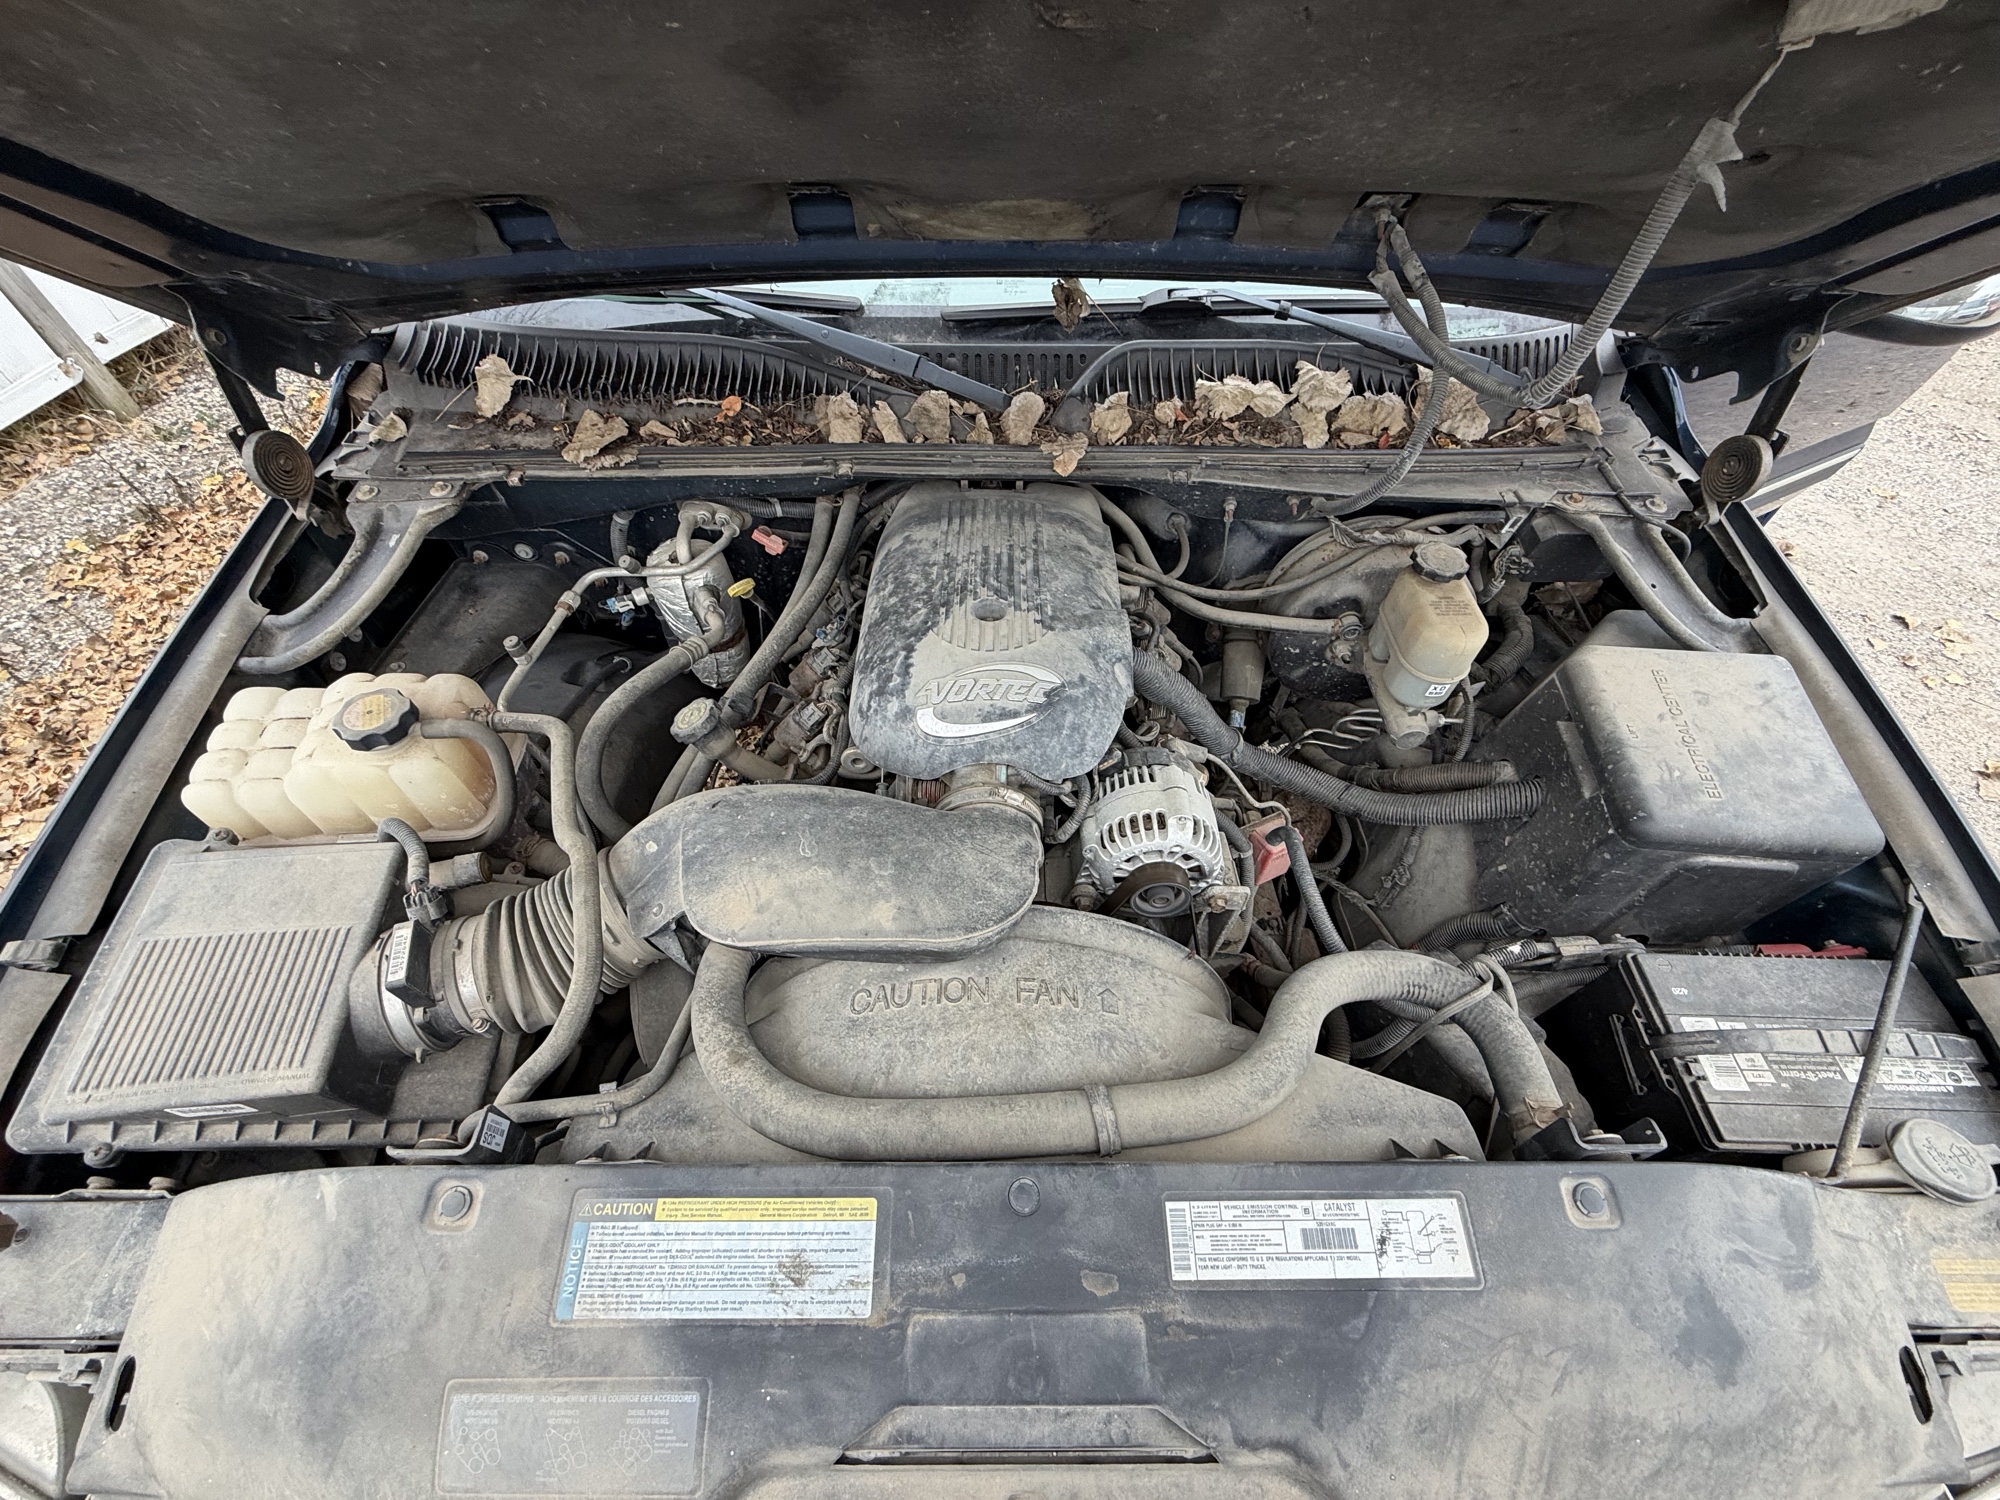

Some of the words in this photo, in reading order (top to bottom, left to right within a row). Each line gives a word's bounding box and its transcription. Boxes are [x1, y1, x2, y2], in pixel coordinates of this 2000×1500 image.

[923, 678, 1052, 704] VORTEC
[1650, 668, 1684, 718] CENTER
[1626, 724, 1640, 740] LIFT
[1674, 720, 1723, 800] ELECTRICAL
[849, 976, 990, 1016] CAUTION
[1016, 976, 1079, 1008] FAN
[1780, 1070, 1808, 1079] Farm
[1818, 1071, 1842, 1080] Fleet
[594, 1202, 654, 1216] CAUTION
[1324, 1203, 1355, 1212] CATALYST
[563, 1238, 584, 1298] NOTICE
